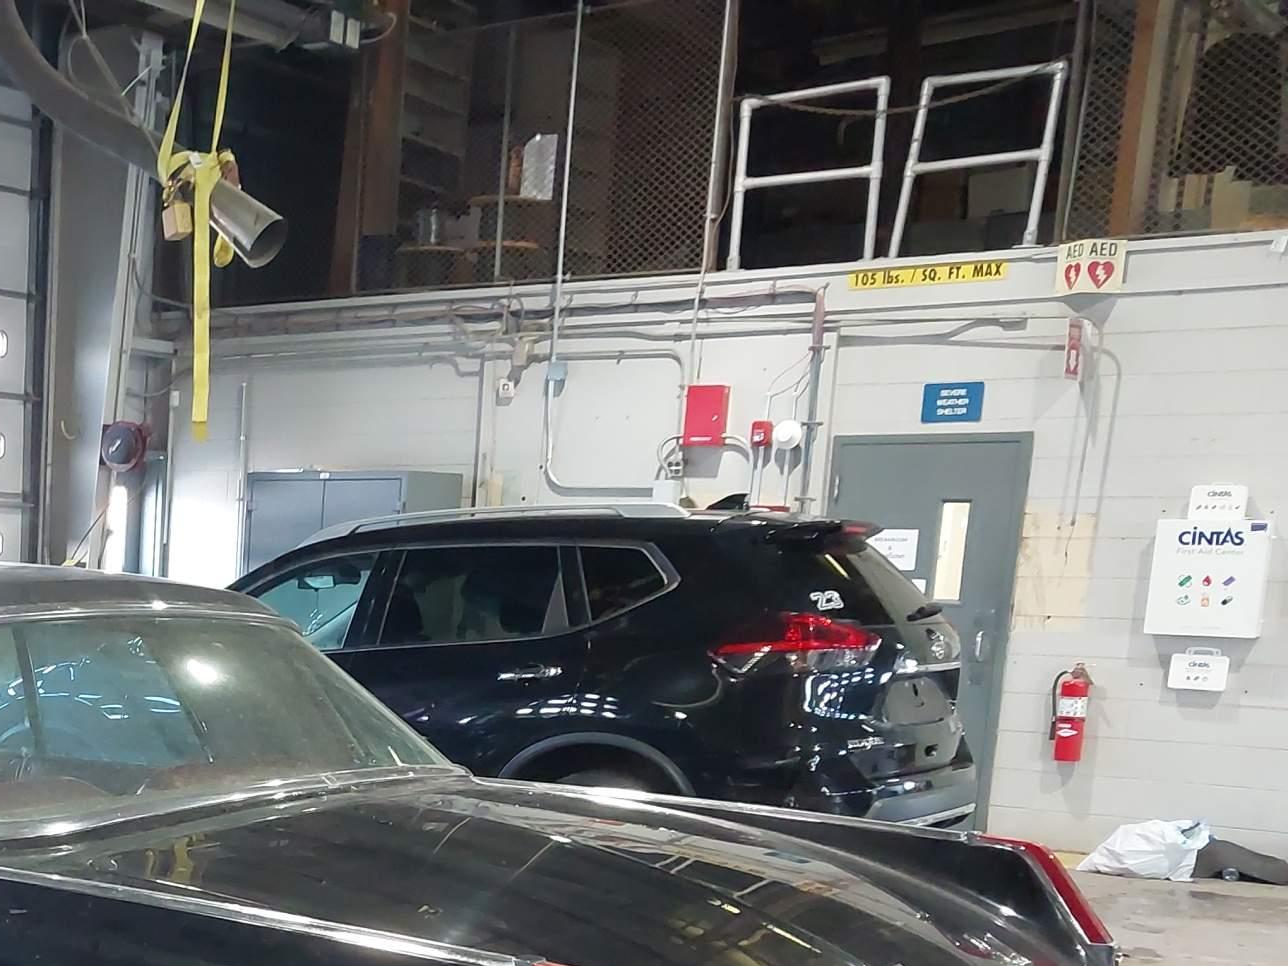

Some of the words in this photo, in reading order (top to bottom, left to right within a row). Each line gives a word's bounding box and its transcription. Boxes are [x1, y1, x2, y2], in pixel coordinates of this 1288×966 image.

[1066, 244, 1083, 260] AED
[1089, 242, 1118, 256] AED
[855, 272, 877, 287] 105
[921, 268, 941, 282] SQ.
[948, 266, 966, 279] FT.
[972, 263, 1003, 277] MAX
[809, 590, 845, 610] 23
